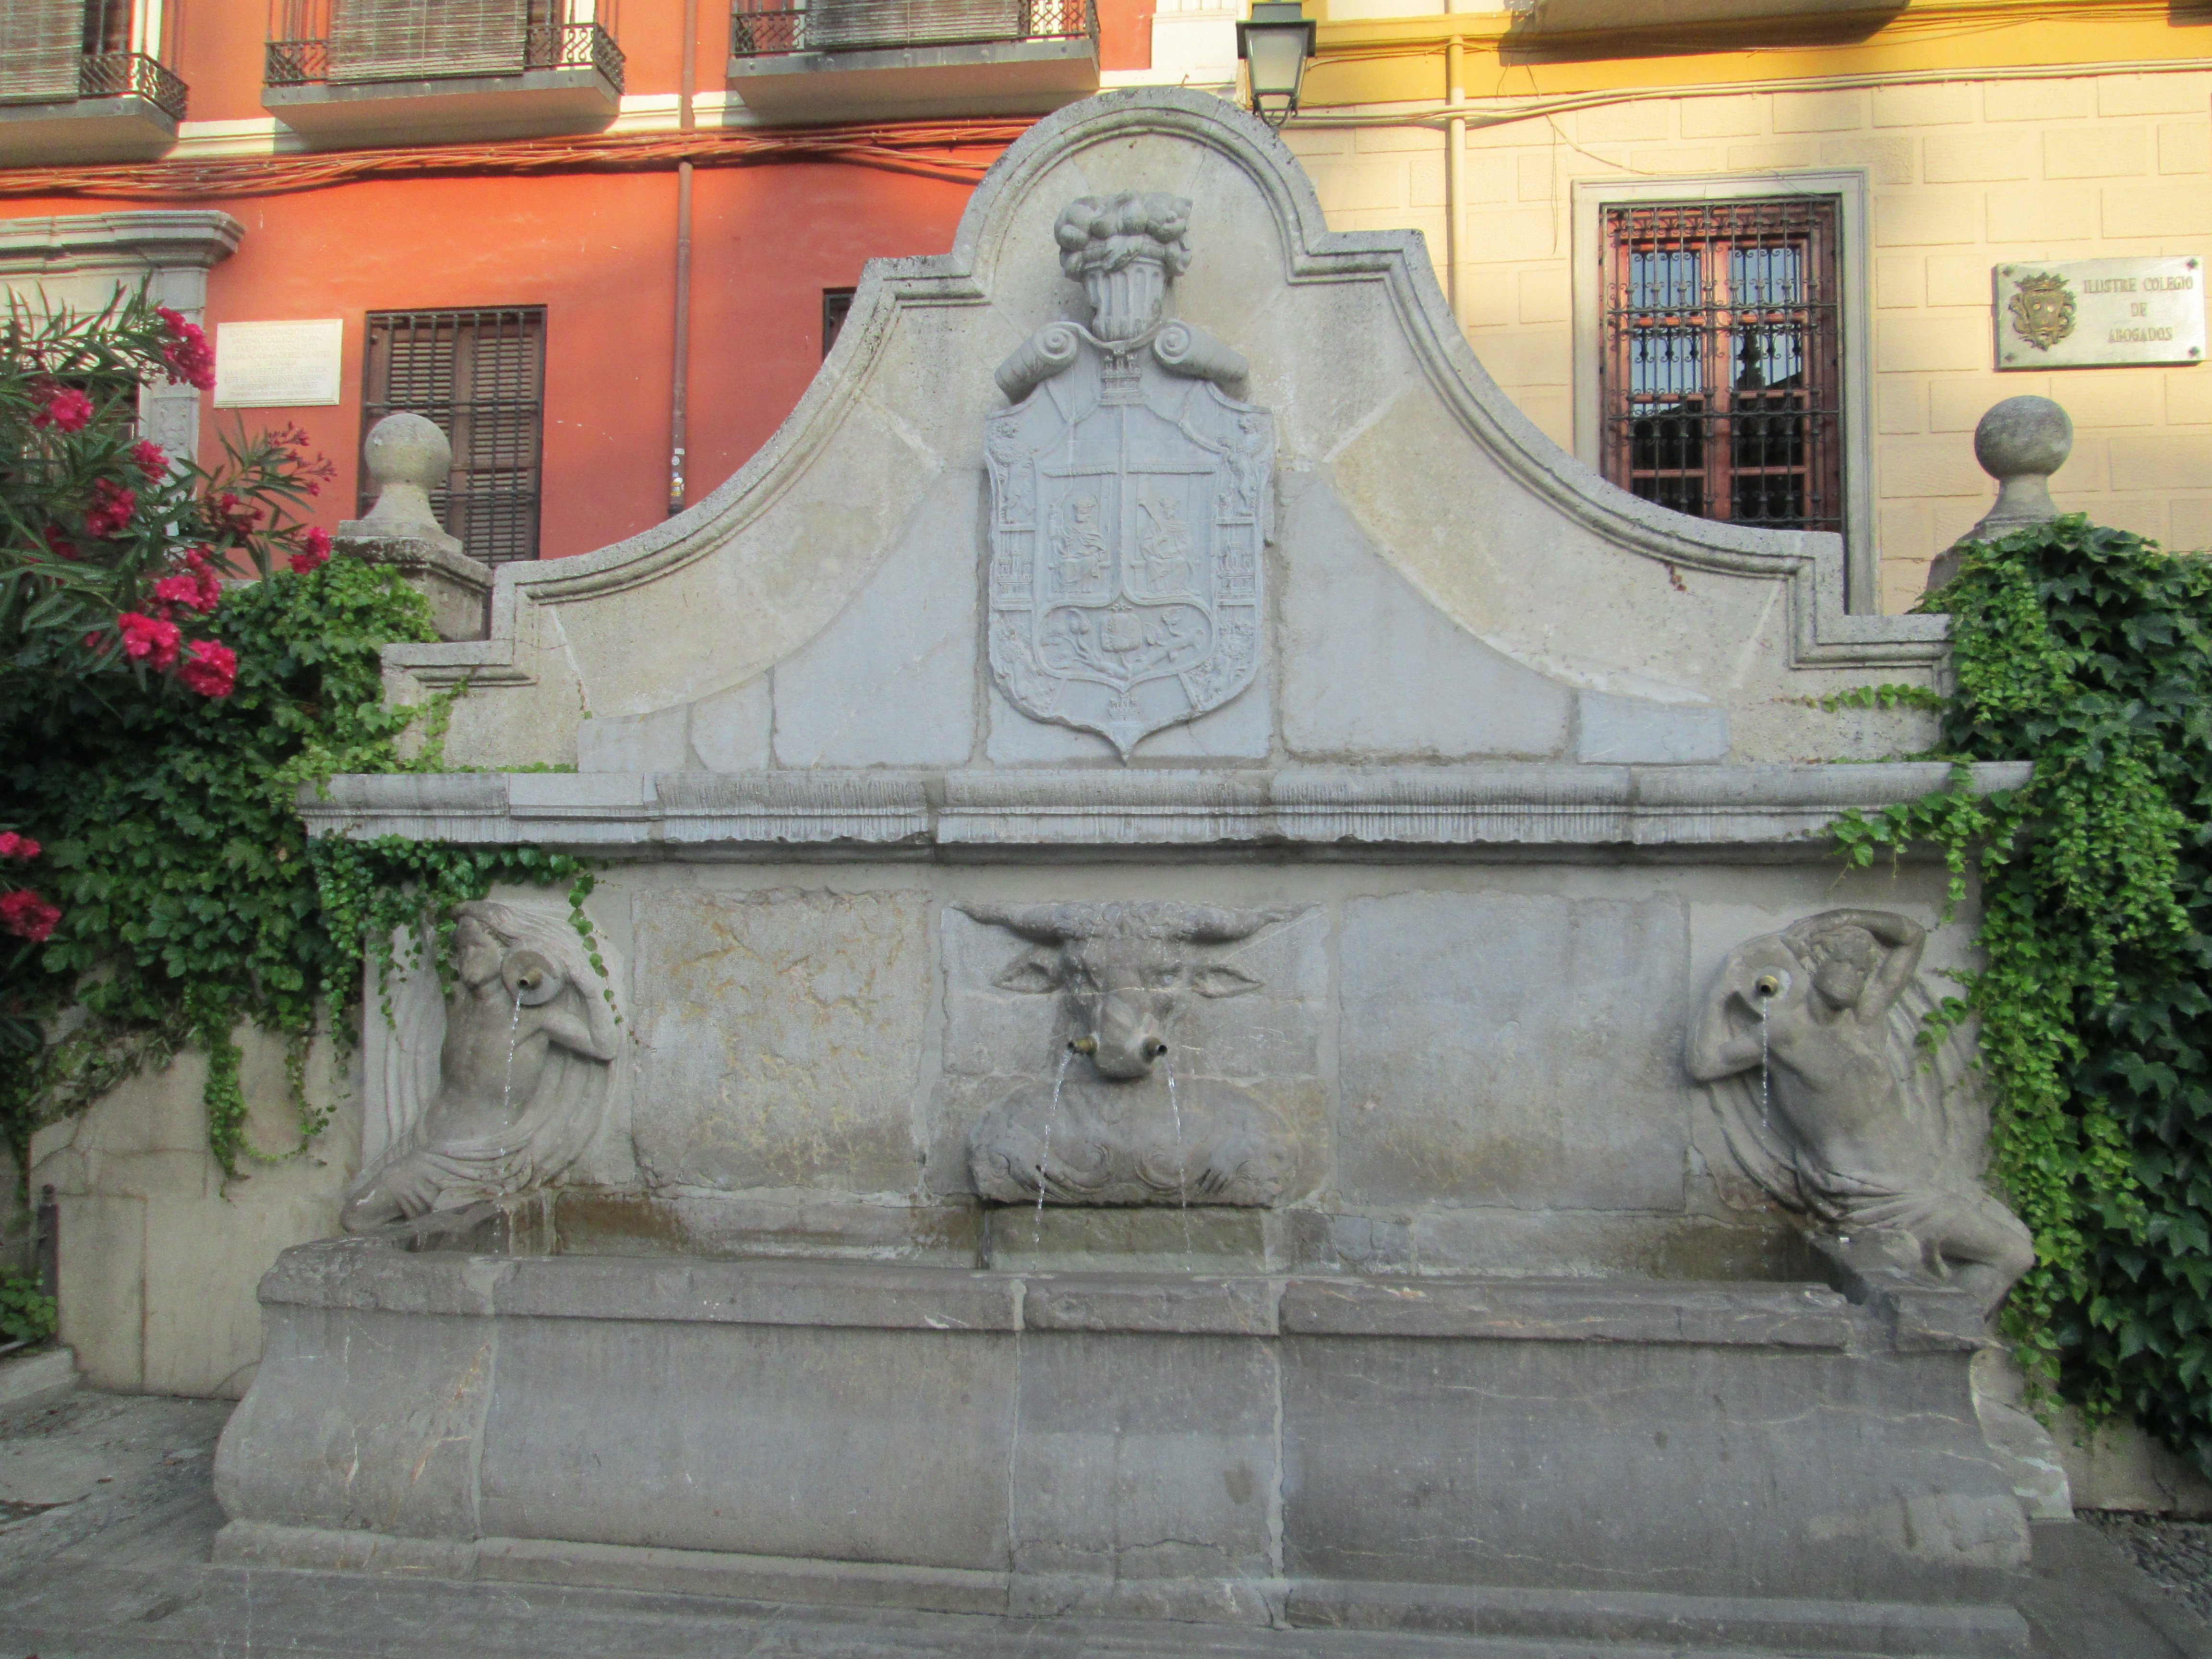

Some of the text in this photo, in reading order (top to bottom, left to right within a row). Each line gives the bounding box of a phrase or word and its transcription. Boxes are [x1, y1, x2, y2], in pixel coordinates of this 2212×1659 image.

[2083, 276, 2192, 294] ILUSTRE COLEGIO
[2131, 302, 2147, 316] DE
[2108, 327, 2172, 343] ABOGADOS
